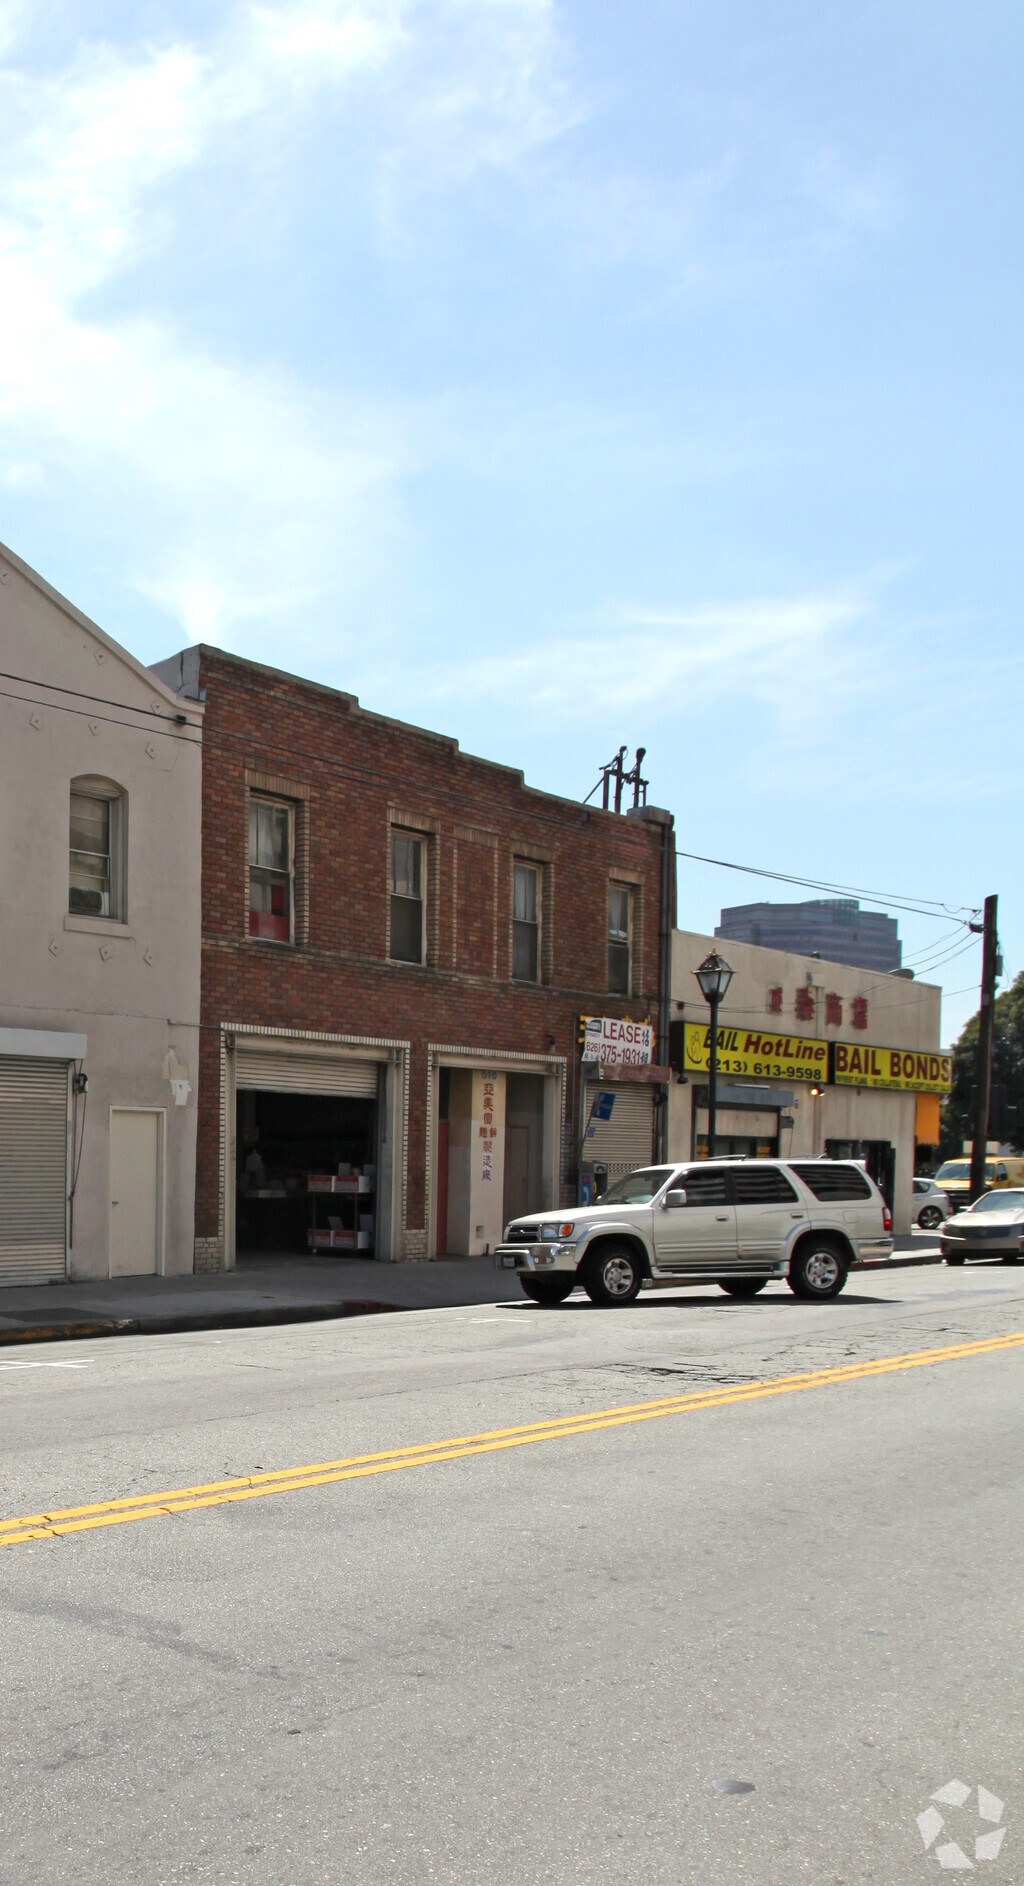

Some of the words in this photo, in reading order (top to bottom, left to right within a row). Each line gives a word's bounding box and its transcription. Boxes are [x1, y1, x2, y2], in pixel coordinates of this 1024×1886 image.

[603, 1021, 641, 1044] LEASE
[601, 1044, 640, 1064] 375-1931
[743, 1034, 826, 1061] HotLine
[706, 1057, 747, 1073] (213)
[753, 1062, 822, 1080] 613-9598
[836, 1045, 881, 1075] BAIL
[890, 1052, 951, 1082] BONDS
